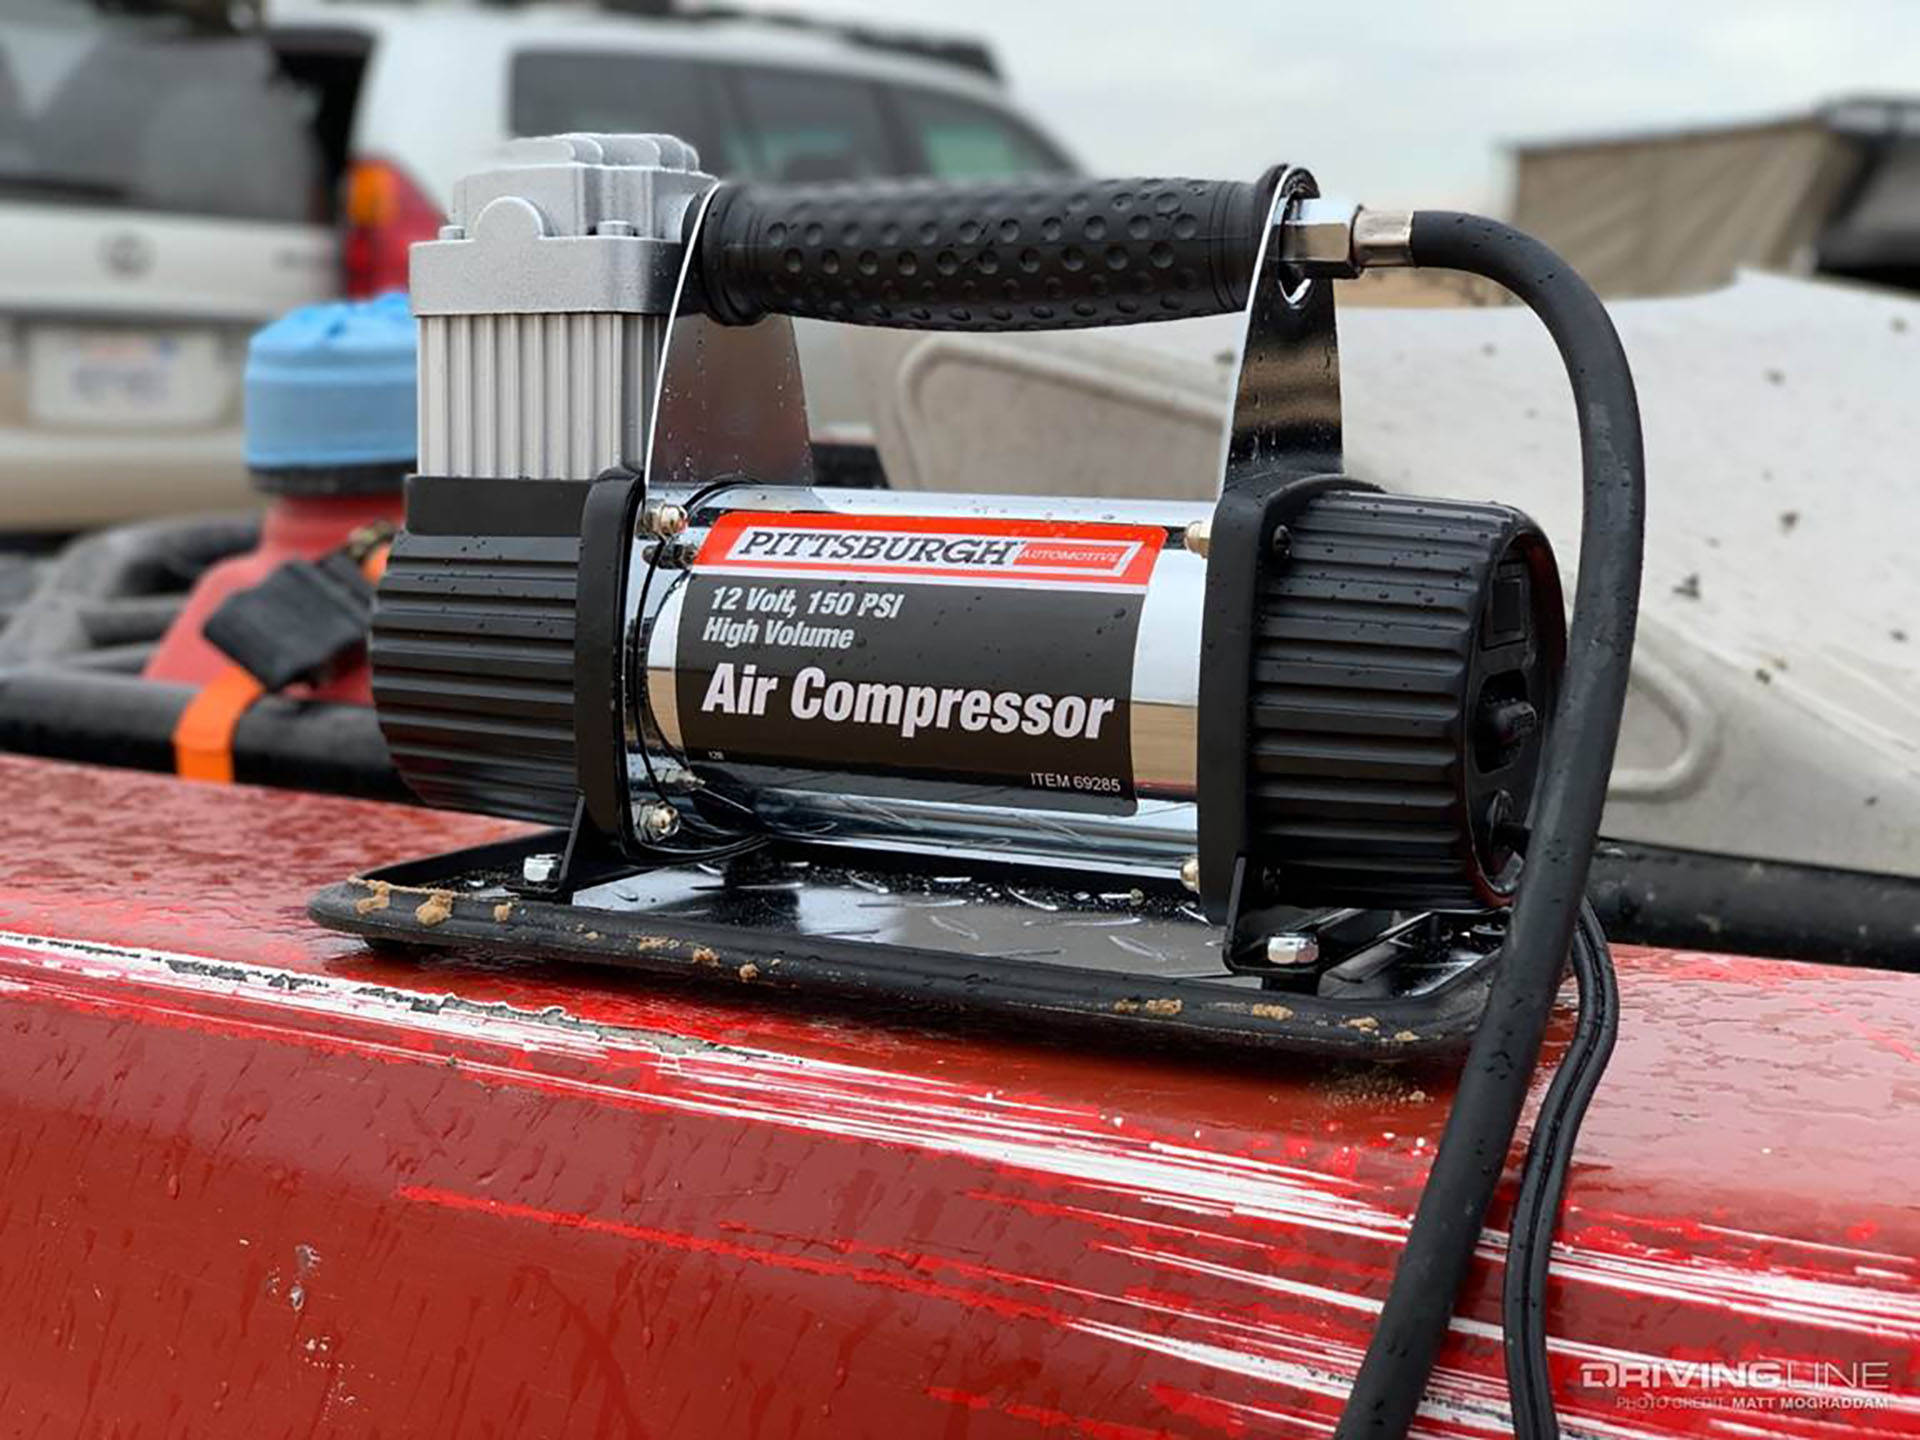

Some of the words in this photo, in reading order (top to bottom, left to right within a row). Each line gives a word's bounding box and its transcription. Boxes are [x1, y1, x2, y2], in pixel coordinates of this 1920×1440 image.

[738, 531, 1027, 566] PITTSBURGH
[1019, 549, 1121, 563] AUTOMOTIVE
[710, 586, 742, 611] 12
[745, 587, 797, 618] Volt,
[808, 591, 854, 617] 150
[857, 592, 904, 618] PSI
[702, 617, 760, 649] High
[764, 619, 854, 650] Volume
[701, 662, 778, 716] Air
[790, 666, 1115, 739] Compressor
[1030, 772, 1070, 788] ITEM
[1073, 775, 1121, 792] 69285
